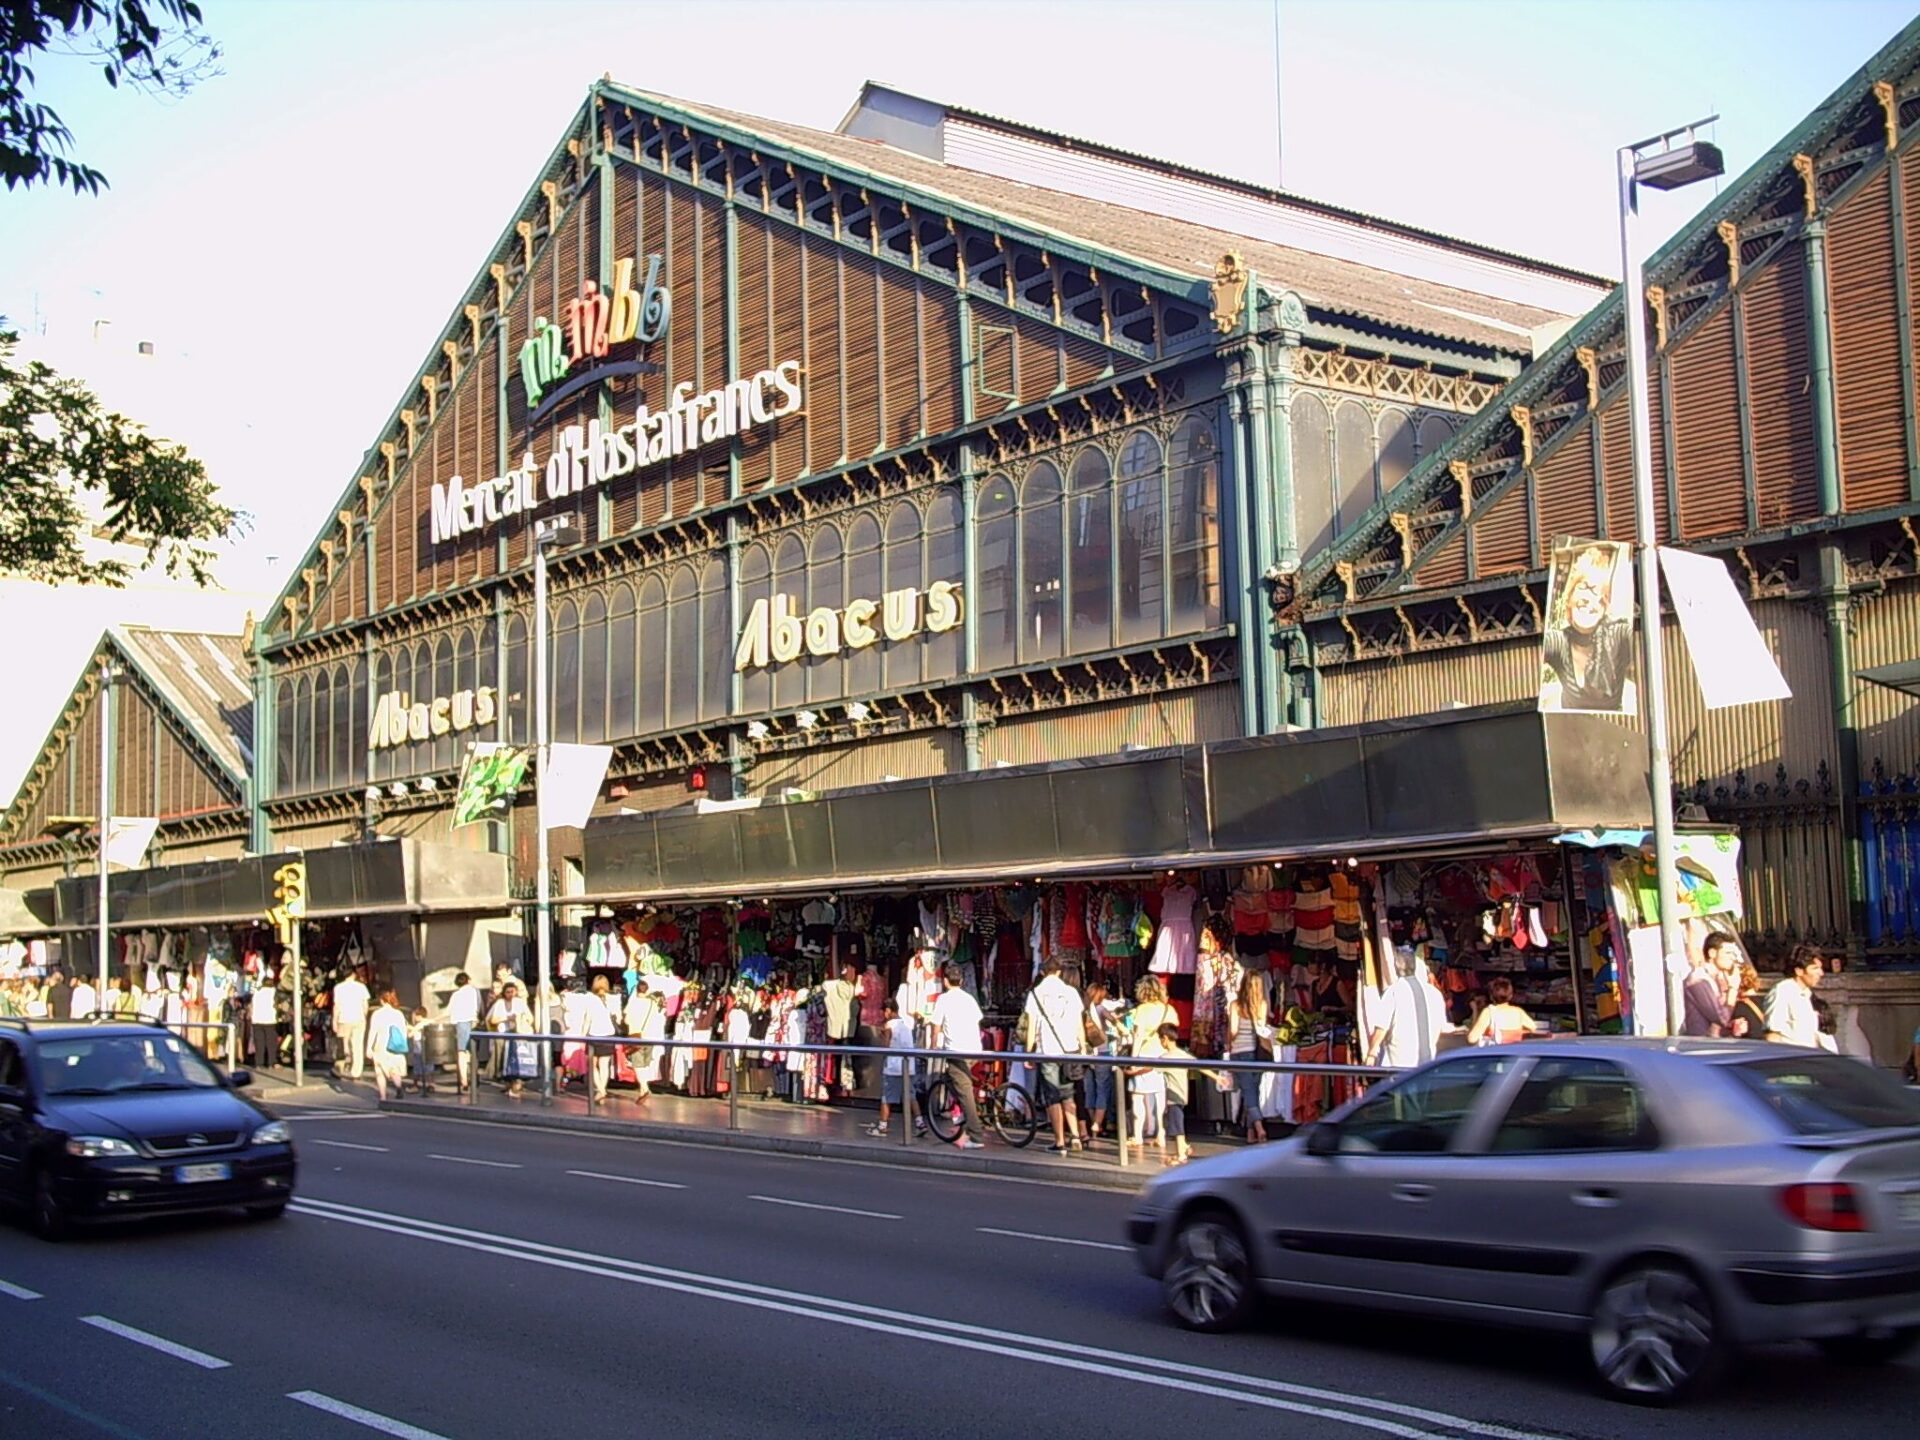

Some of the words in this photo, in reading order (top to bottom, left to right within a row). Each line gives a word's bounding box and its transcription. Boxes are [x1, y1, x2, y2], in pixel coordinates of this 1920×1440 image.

[431, 452, 538, 545] Mercat
[546, 360, 802, 498] d'Hostafrancs
[735, 580, 964, 671] Abacus
[368, 685, 496, 748] Abacus
